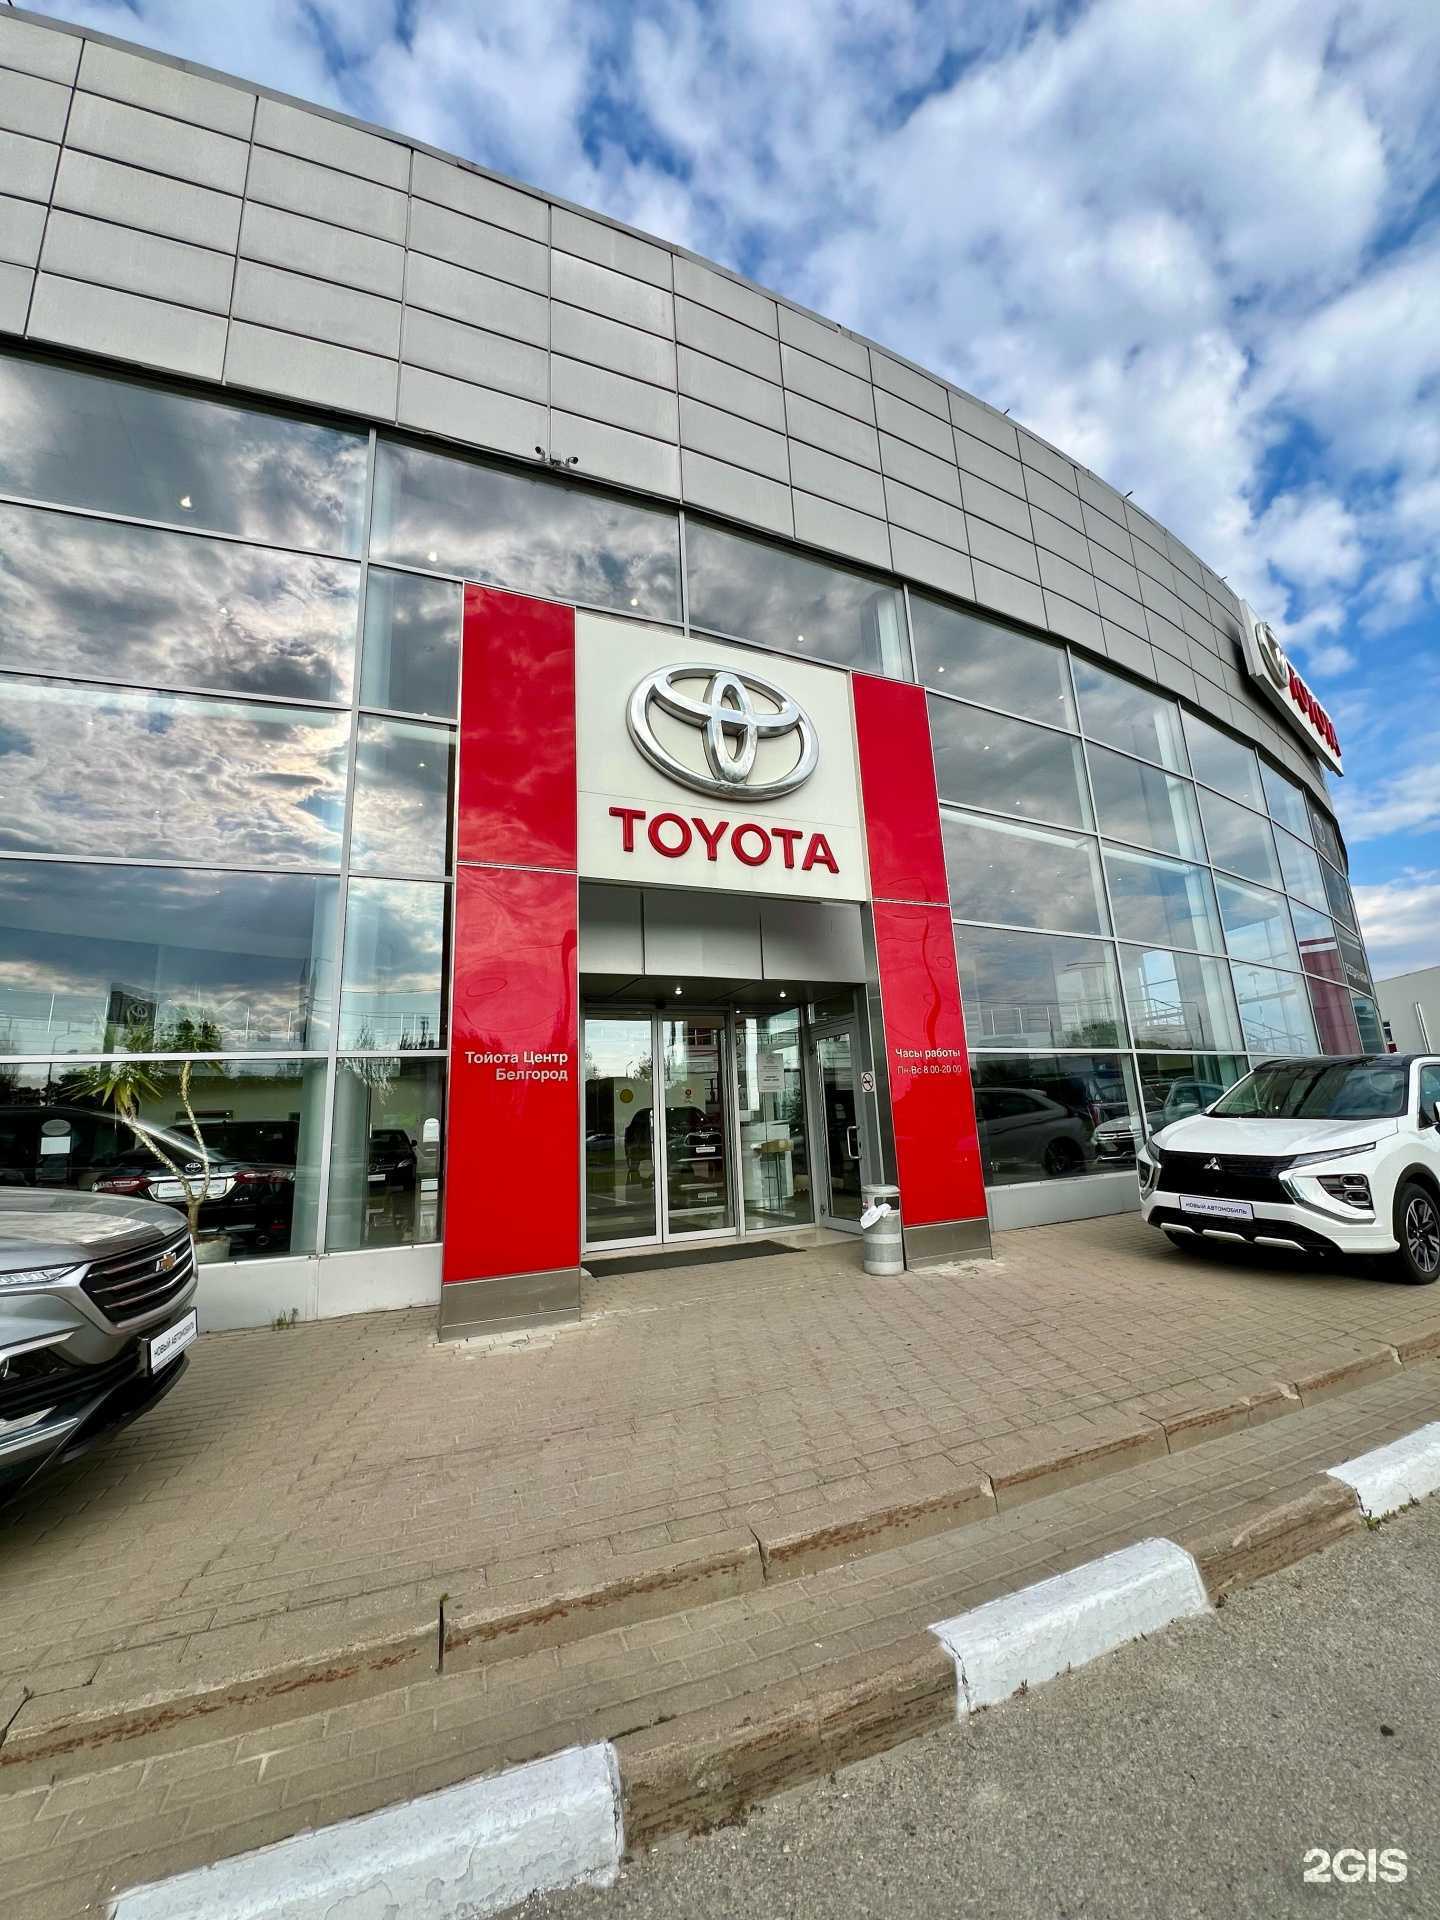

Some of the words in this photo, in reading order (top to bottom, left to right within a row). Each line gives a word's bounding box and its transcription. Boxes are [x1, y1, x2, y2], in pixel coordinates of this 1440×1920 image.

[609, 807, 839, 873] TOYOTA
[465, 1050, 519, 1064] Тойота
[523, 1050, 568, 1065] Центр
[895, 1047, 922, 1058] Часы
[925, 1047, 961, 1060] работы
[496, 1067, 568, 1083] Белгород
[1207, 1205, 1248, 1215] АВТОМОБИЛЬ
